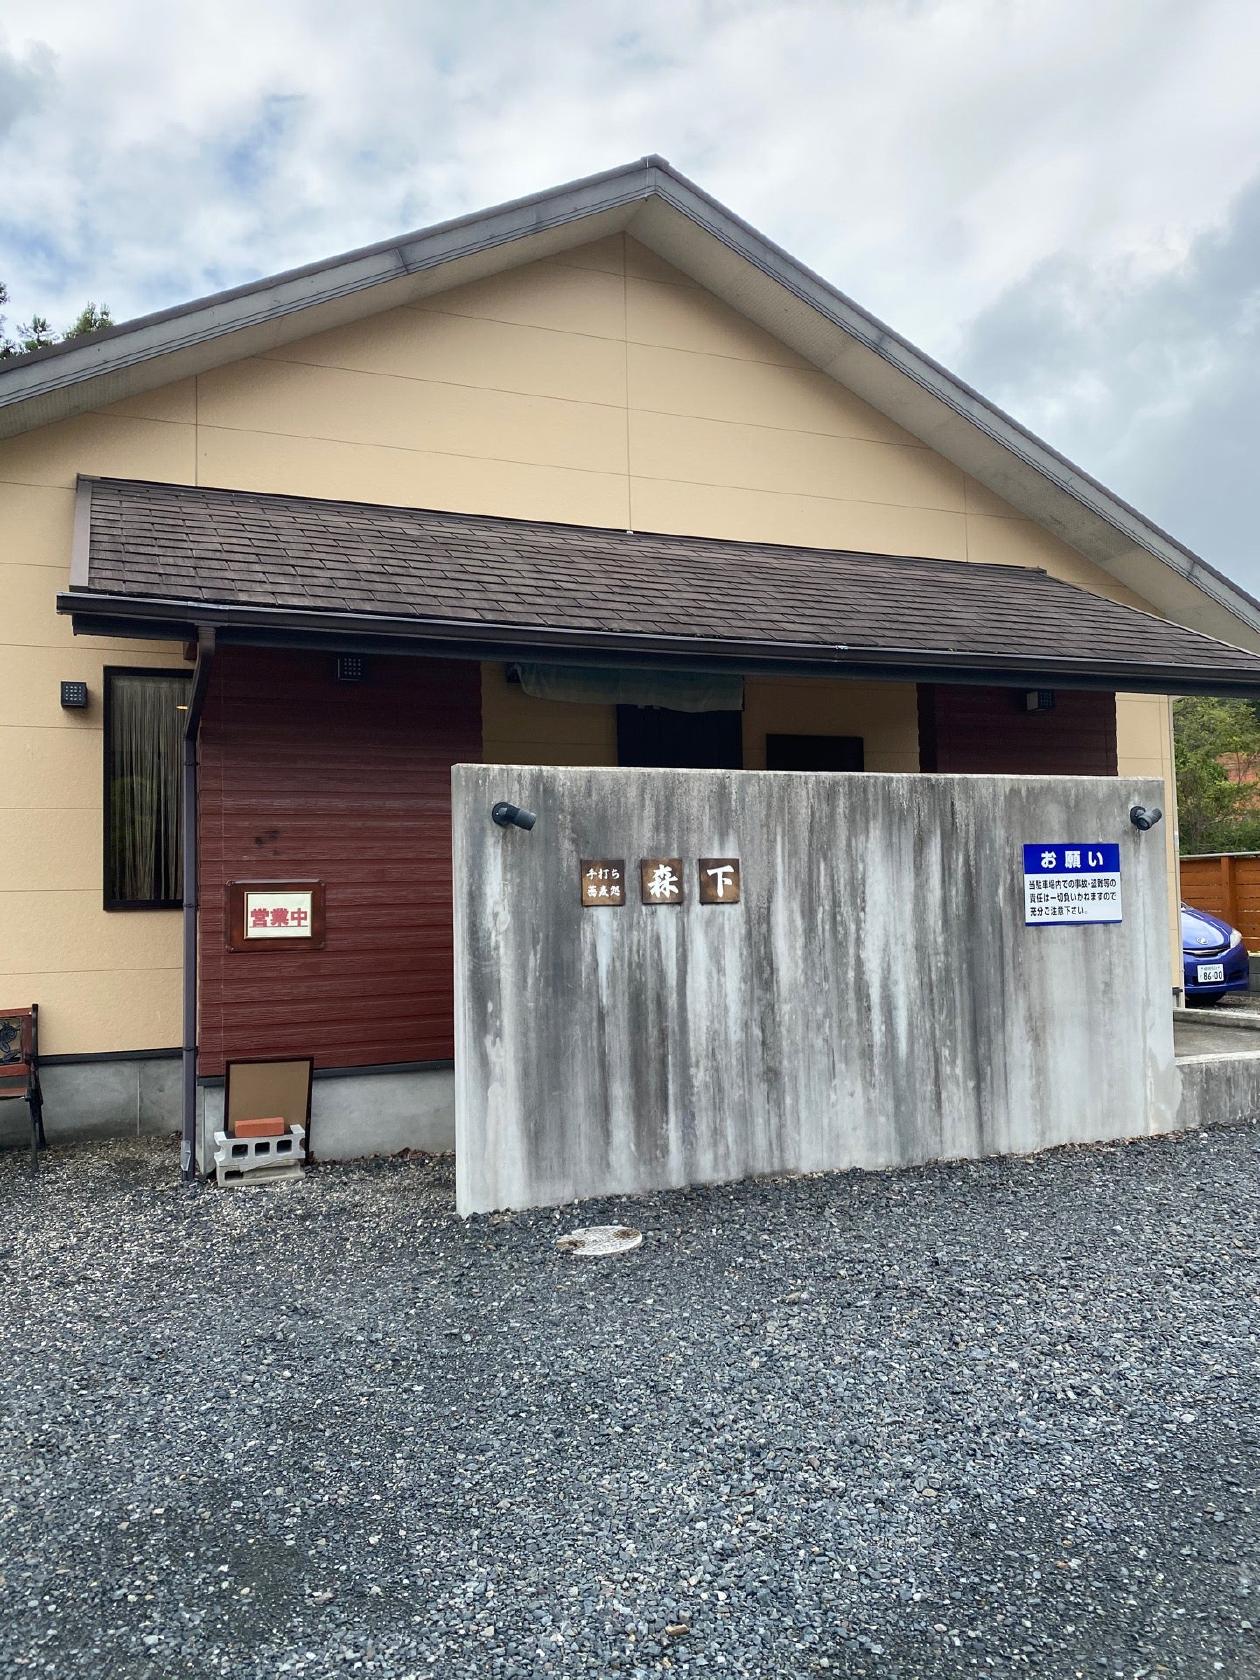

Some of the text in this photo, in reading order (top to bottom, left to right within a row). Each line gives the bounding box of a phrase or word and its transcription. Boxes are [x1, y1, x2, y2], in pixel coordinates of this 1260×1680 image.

[1041, 851, 1104, 869] お願い
[586, 868, 620, 880] 手打ち
[648, 864, 735, 898] 森 下
[587, 885, 621, 898] 蕎麦処
[1029, 892, 1117, 903] 責任は一切負いかねますので
[250, 907, 308, 928] 営業中
[1030, 906, 1088, 917] 充分ご注意下さい。
